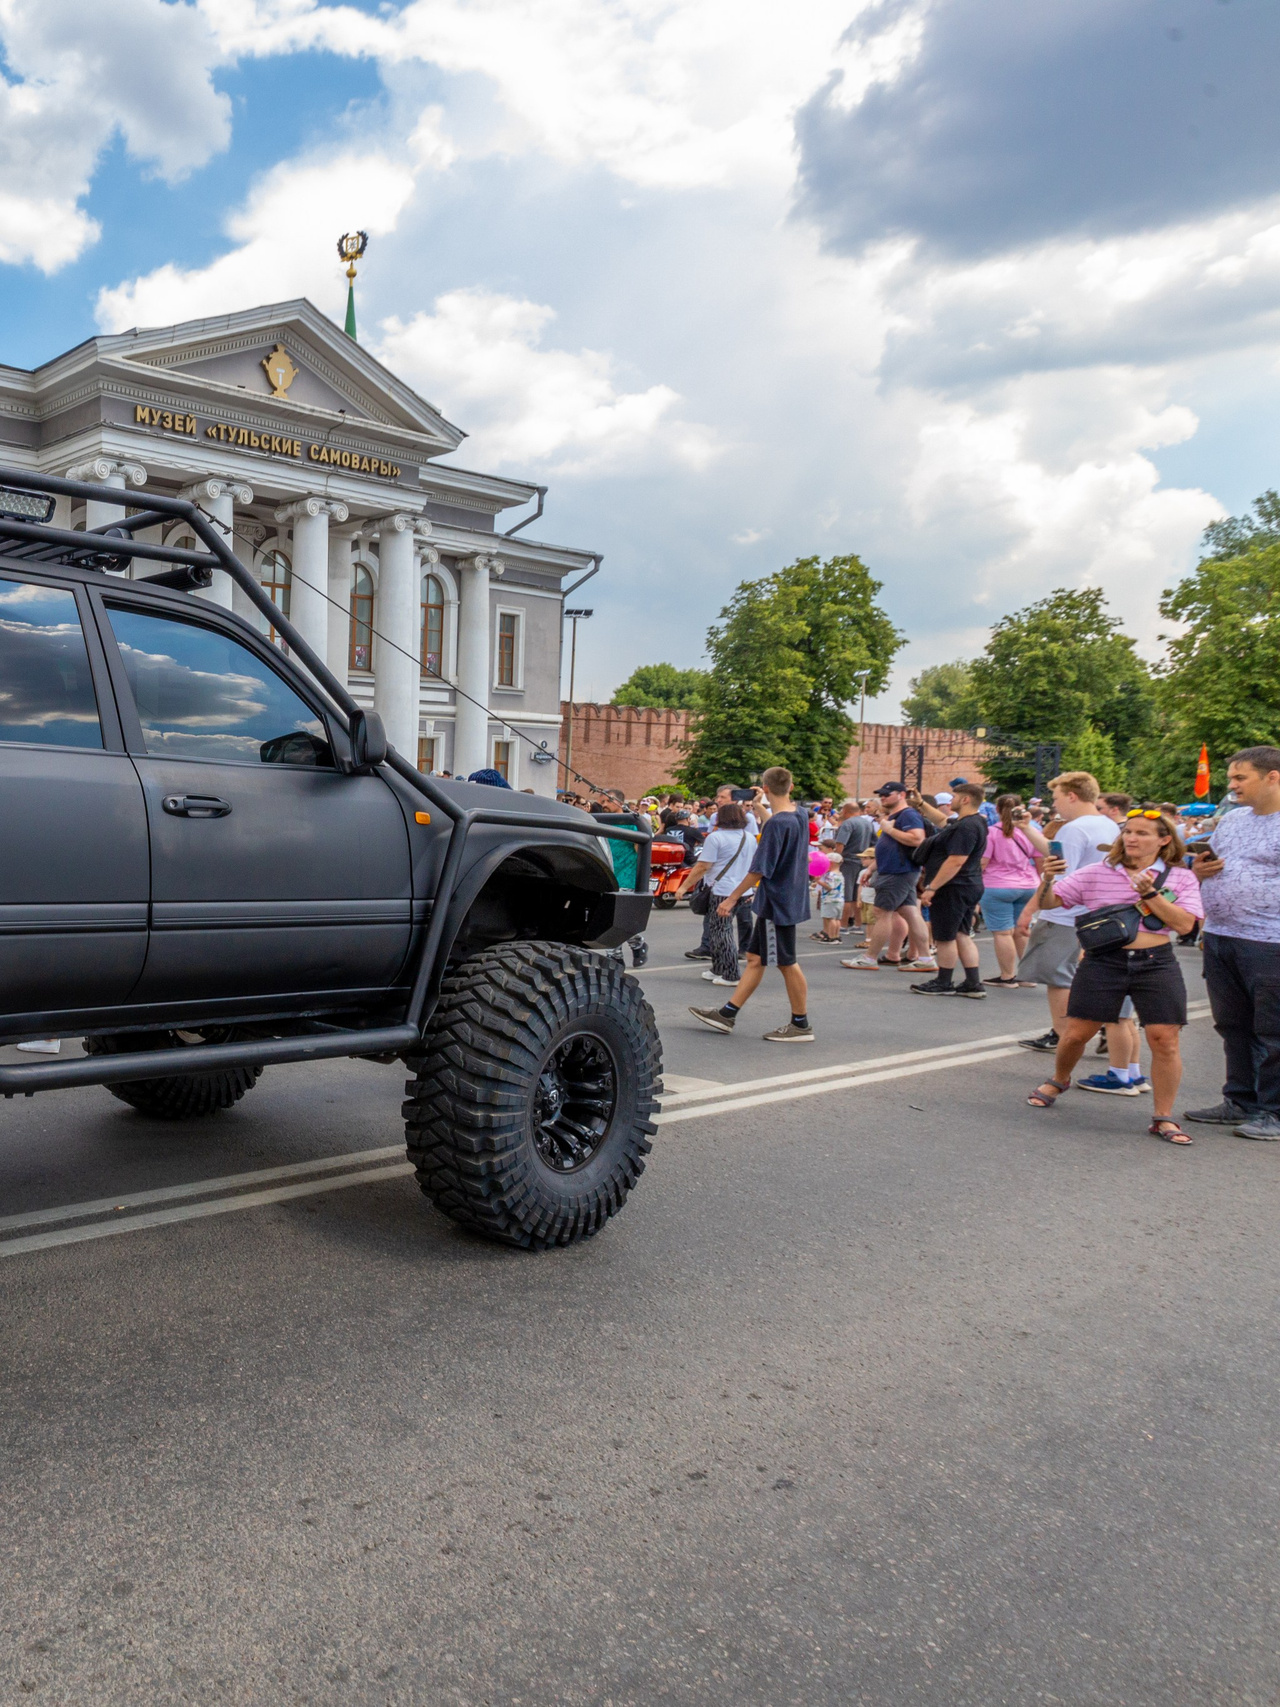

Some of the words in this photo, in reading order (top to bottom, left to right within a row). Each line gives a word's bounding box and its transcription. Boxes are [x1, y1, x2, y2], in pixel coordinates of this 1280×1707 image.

[135, 404, 197, 435] МУЗЕЙ
[206, 423, 302, 457] «ТУЛЬСКИЕ
[310, 443, 402, 477] САМОВАРЫ»
